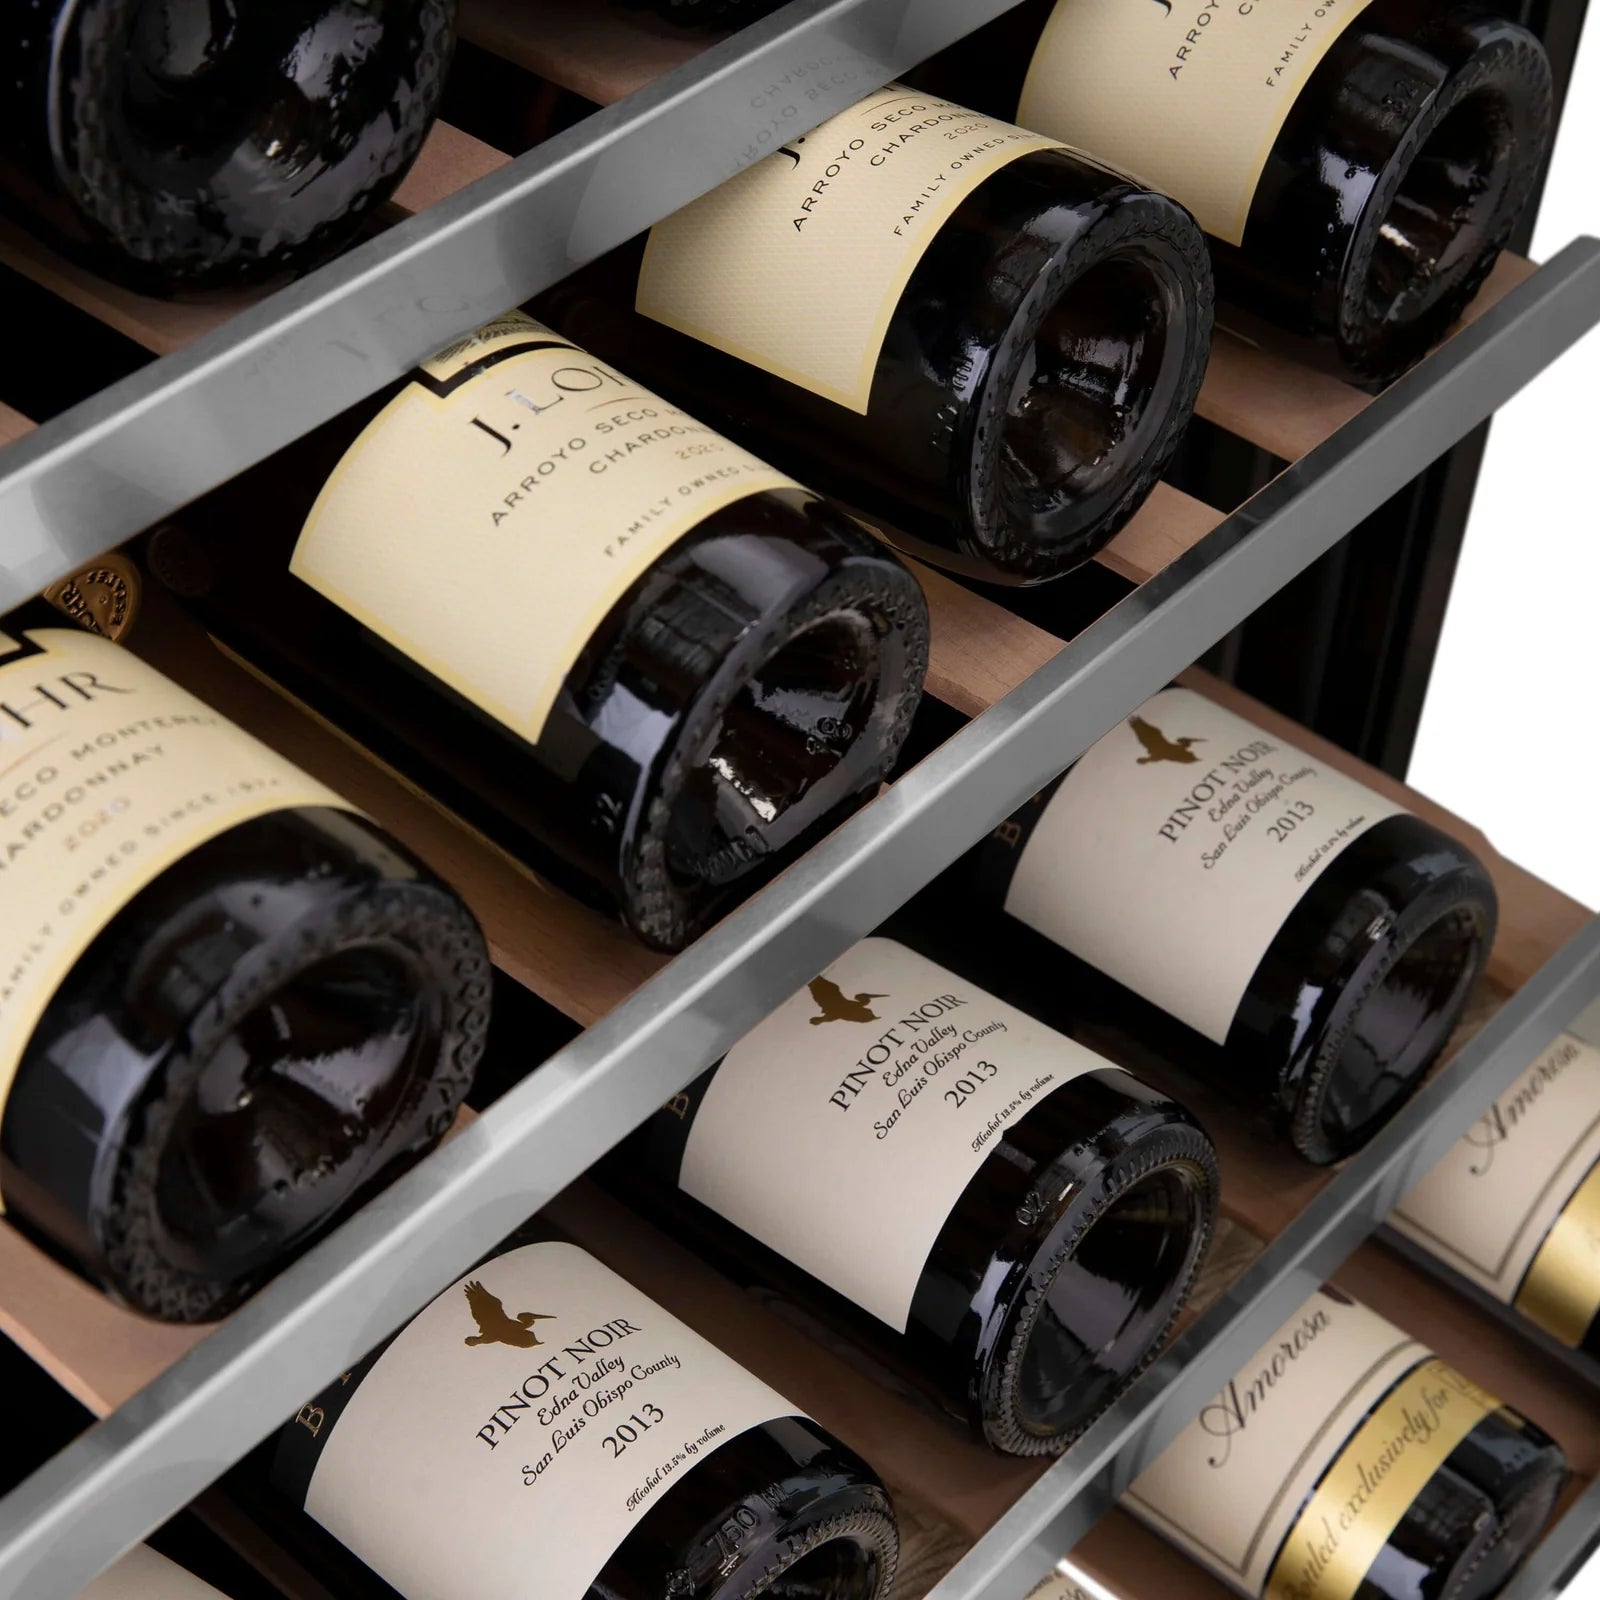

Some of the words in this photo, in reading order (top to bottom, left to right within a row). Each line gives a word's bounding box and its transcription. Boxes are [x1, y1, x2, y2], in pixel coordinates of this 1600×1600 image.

[1266, 22, 1313, 87] FAMILY
[793, 138, 865, 232] ARROYO
[870, 103, 927, 132] SECO
[943, 121, 988, 140] 2020
[893, 173, 947, 236] FAMILY
[950, 137, 1005, 170] OWNED
[468, 414, 521, 457] J.
[490, 437, 587, 526] ARROYO
[595, 407, 659, 434] SECO
[603, 496, 672, 558] FAMILY
[1158, 769, 1227, 844] PINOT
[1220, 741, 1278, 775] NOIR
[1201, 841, 1228, 870] San
[1223, 813, 1252, 842] Luis
[1245, 784, 1284, 814] Obispo
[1278, 767, 1319, 786] County
[1208, 792, 1242, 823] Edna
[1233, 767, 1275, 794] Valley
[1267, 800, 1315, 843] 2013
[58, 840, 138, 916] OWNED
[828, 1028, 906, 1113] PINOT
[899, 993, 968, 1034] NOIR
[873, 1109, 902, 1140] San
[898, 1078, 929, 1110] Luis
[922, 1041, 967, 1077] Obispo
[963, 1019, 1008, 1044] County
[882, 1053, 918, 1088] Edna
[909, 1022, 959, 1059] Valley
[944, 1059, 999, 1108] 2013
[970, 1117, 1003, 1154] Alcohol
[1001, 1099, 1022, 1120] 13.5%
[1020, 1087, 1032, 1103] by
[1029, 1073, 1055, 1095] volume
[1463, 1043, 1580, 1177] Amorosa
[475, 1356, 568, 1451] PINOT
[561, 1317, 643, 1365] NOIR
[522, 1451, 554, 1487] San
[552, 1415, 587, 1454] Luis
[582, 1377, 634, 1418] Obispo
[630, 1351, 682, 1382] County
[537, 1389, 580, 1427] Edna
[571, 1355, 627, 1391] Valley
[1199, 1310, 1332, 1470] Amorosa
[601, 1402, 666, 1459] 2013
[625, 1470, 664, 1512] Alcohol
[661, 1448, 687, 1477] 13.5%
[684, 1440, 700, 1457] by
[697, 1422, 727, 1448] volume
[1339, 1406, 1433, 1532] exclusively
[1420, 1386, 1450, 1433] for
